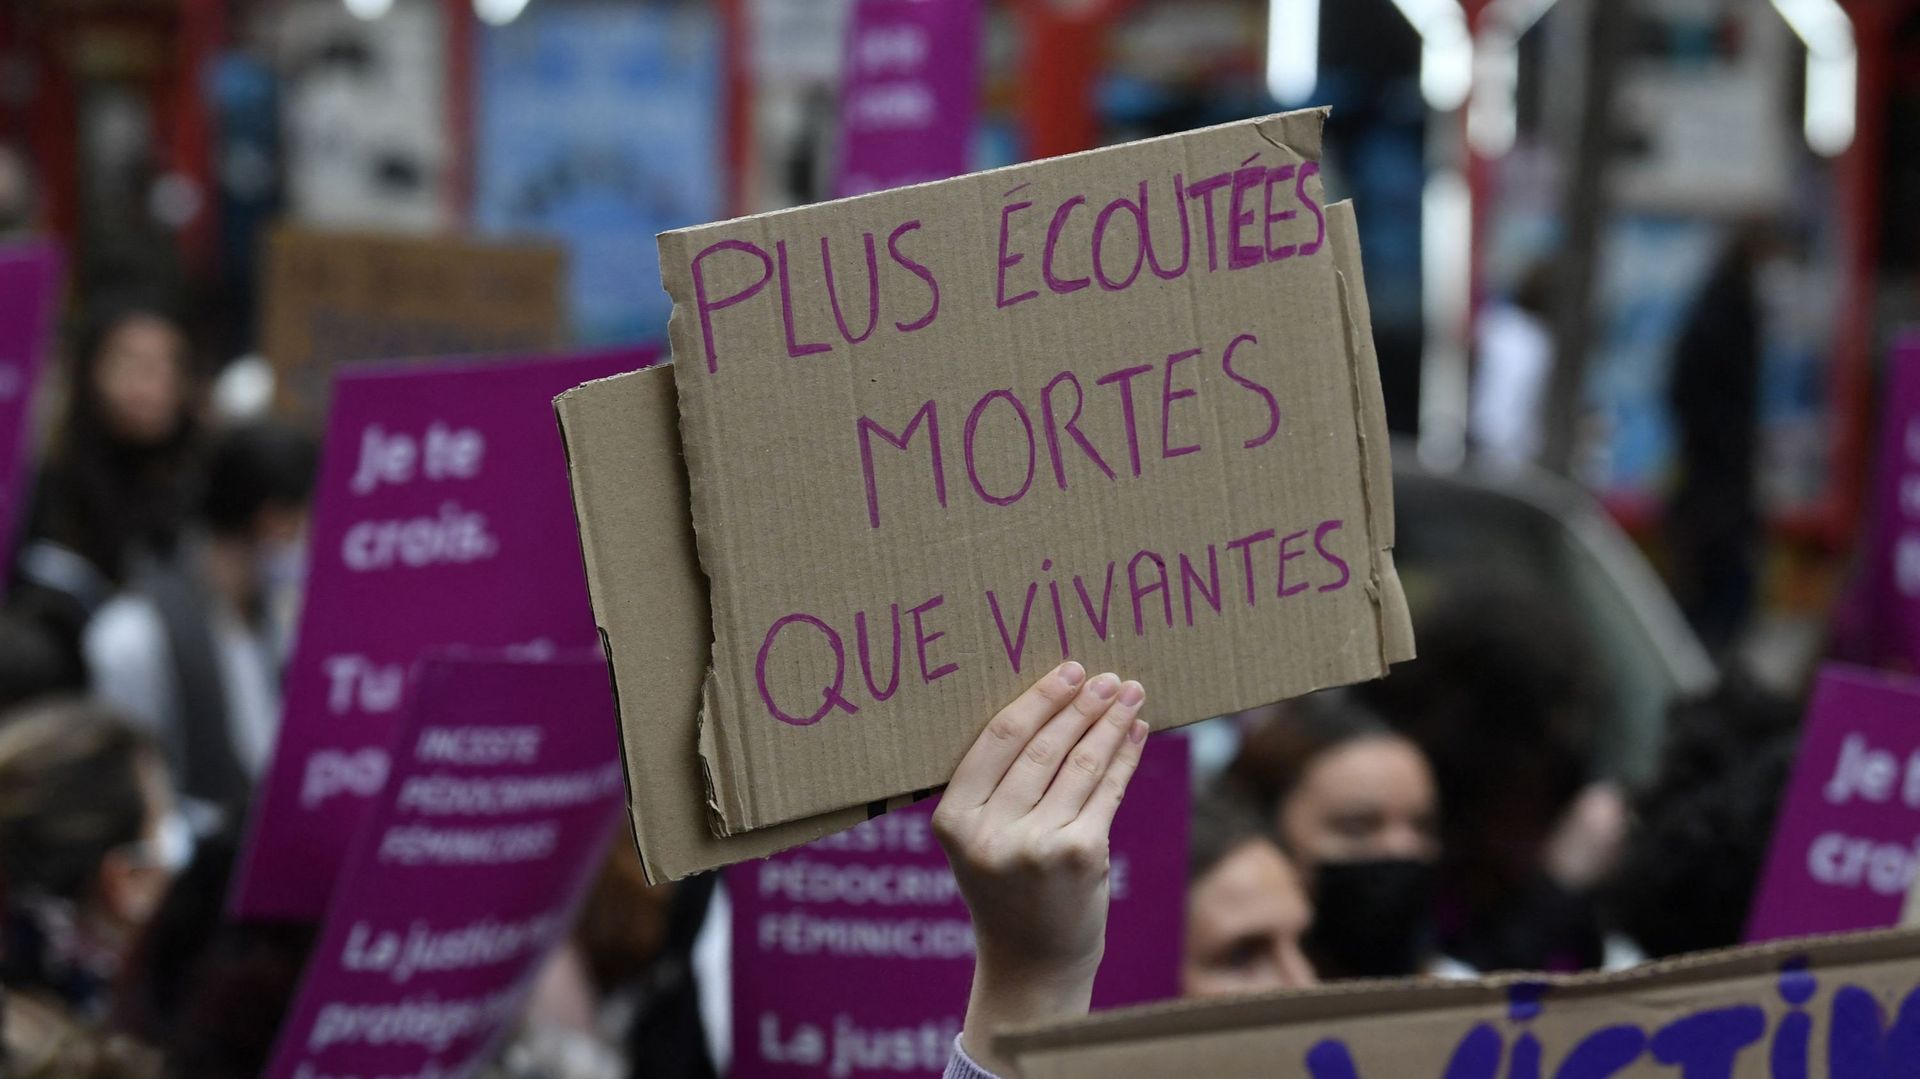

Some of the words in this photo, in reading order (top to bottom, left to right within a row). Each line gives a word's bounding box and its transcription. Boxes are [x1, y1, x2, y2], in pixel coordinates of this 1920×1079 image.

[692, 220, 940, 373] PLUS
[997, 152, 1327, 308] ÉCOUTÉES
[424, 419, 485, 480] te
[857, 334, 1281, 528] MORTES
[756, 597, 959, 726] QUE
[758, 1010, 826, 1065] La
